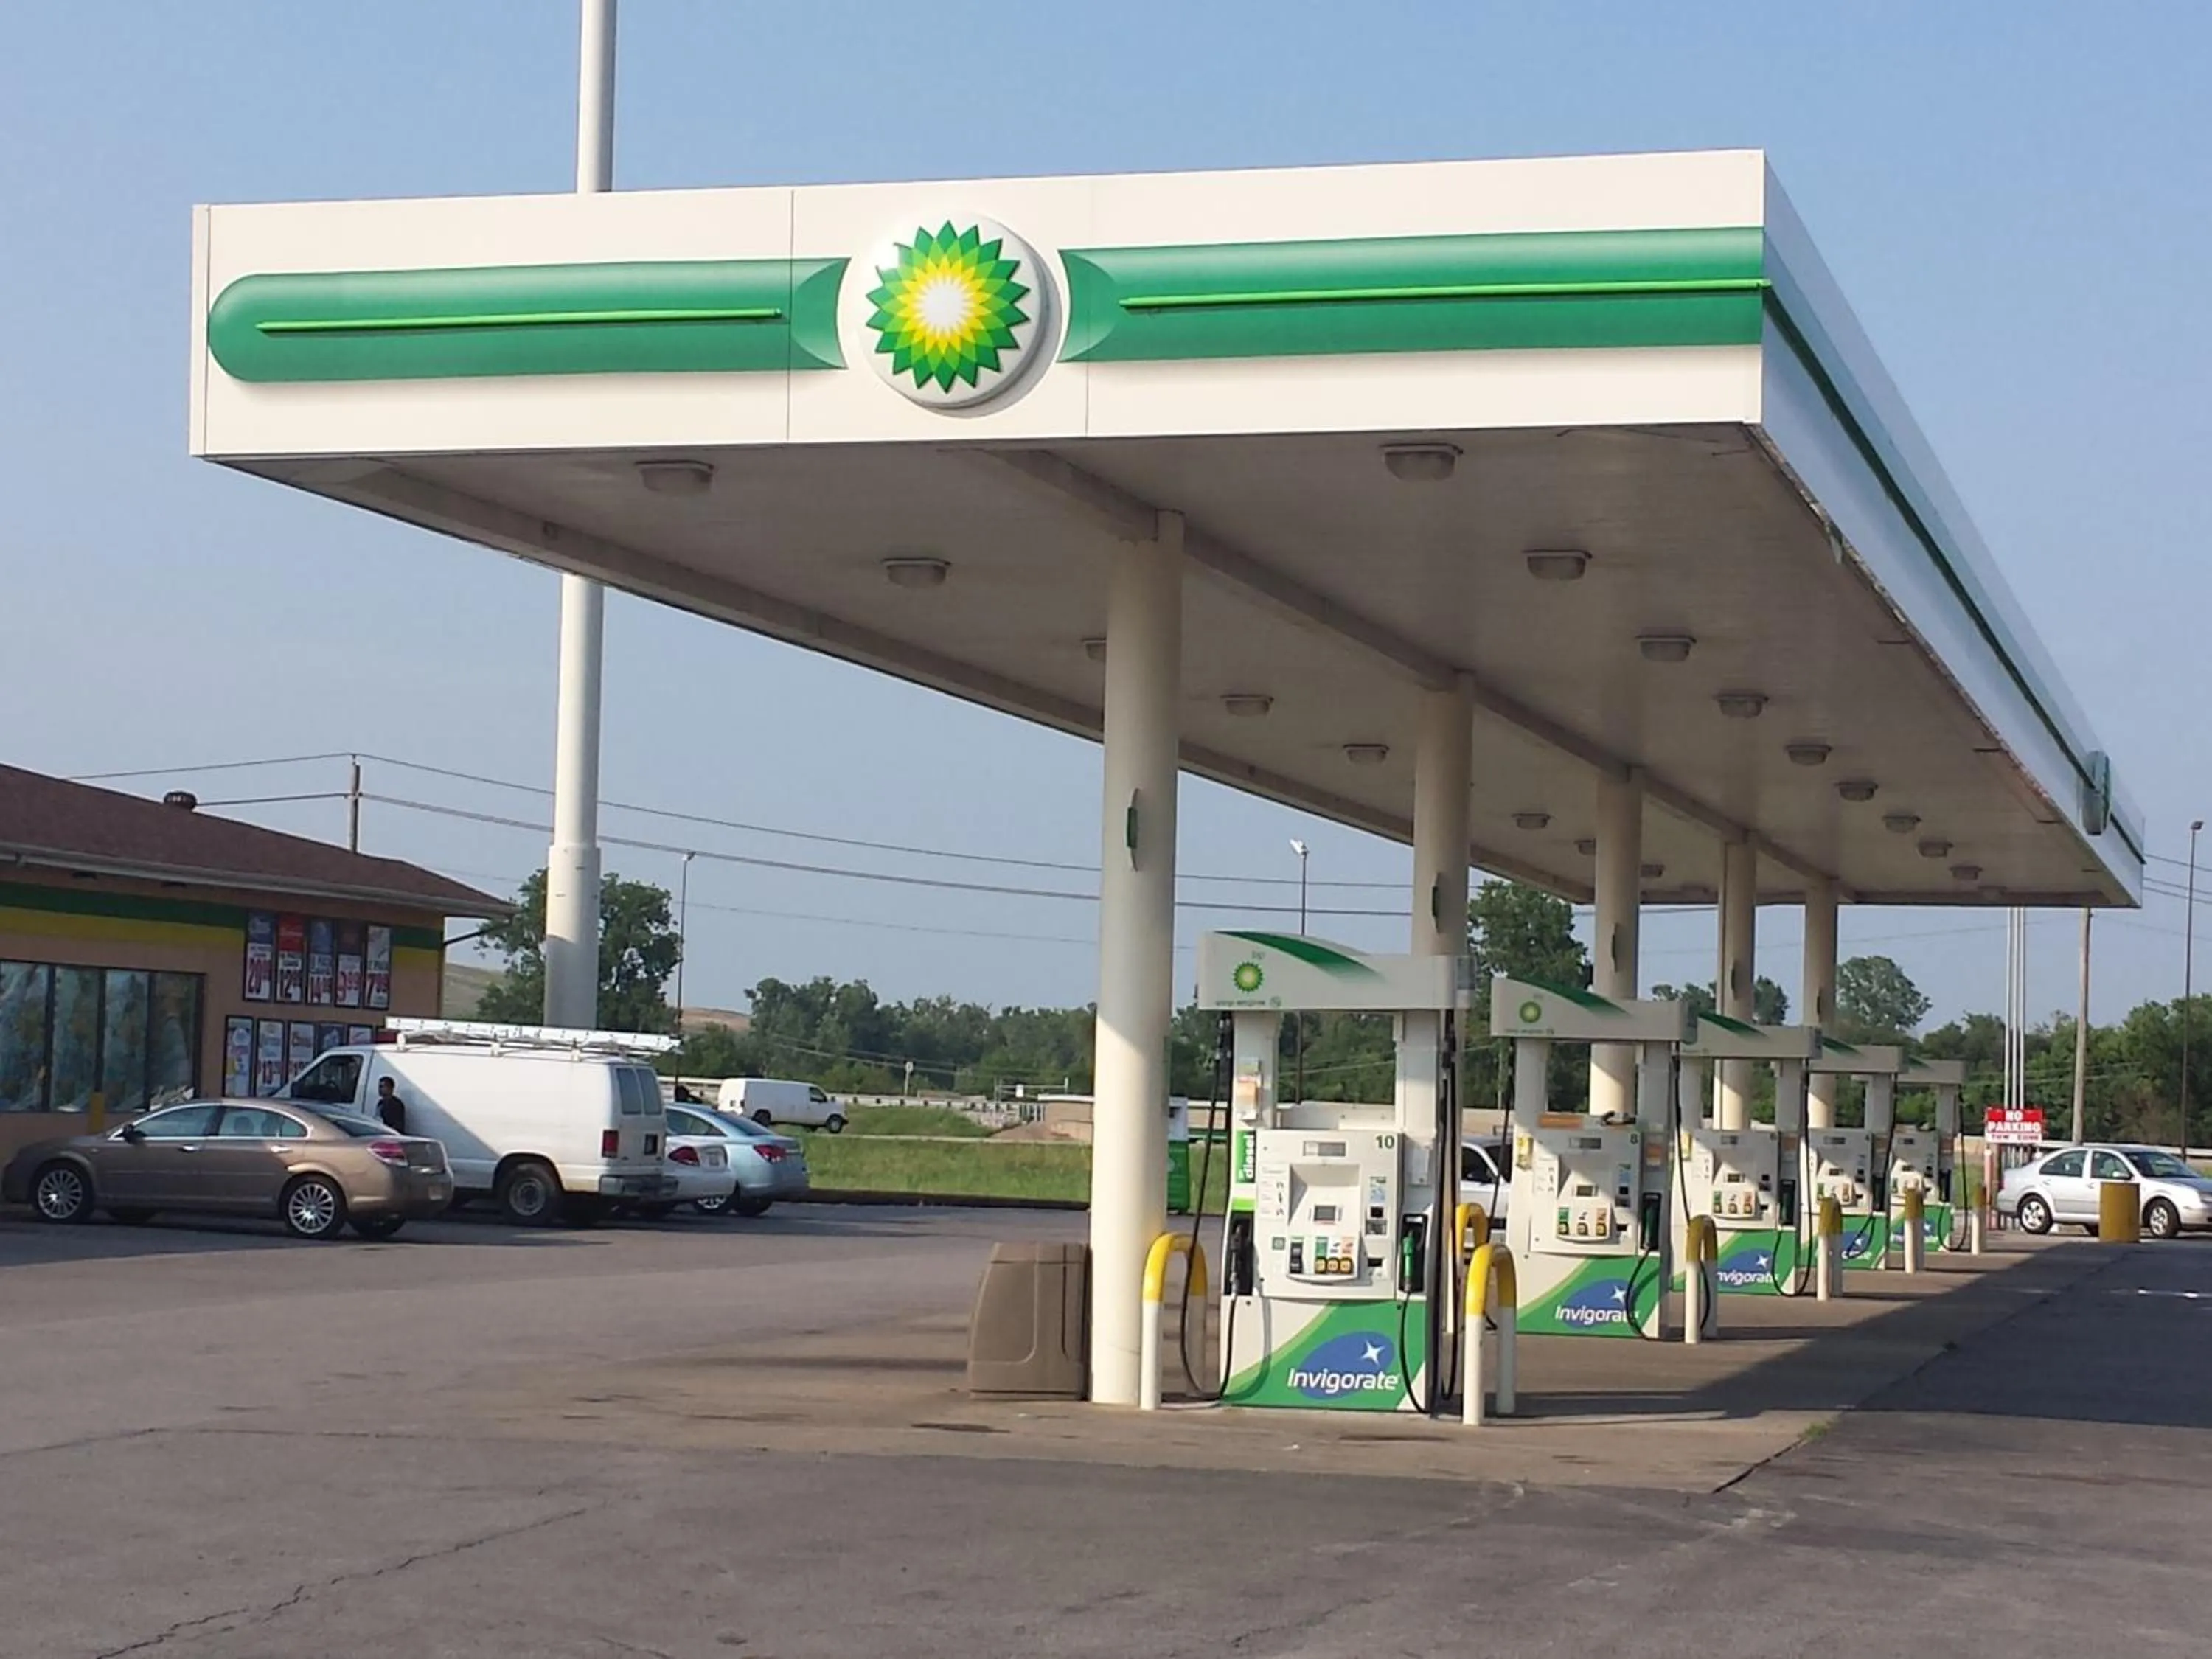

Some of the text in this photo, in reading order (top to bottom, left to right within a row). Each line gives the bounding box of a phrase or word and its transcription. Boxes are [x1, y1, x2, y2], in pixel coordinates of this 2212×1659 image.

[2005, 1110, 2023, 1121] NO
[1987, 1121, 2042, 1133] PARKING
[1376, 1135, 1394, 1149] 10
[1242, 1134, 1254, 1179] diesel
[1717, 1269, 1779, 1286] nvigorat
[1287, 1368, 1399, 1394] Invigorate
